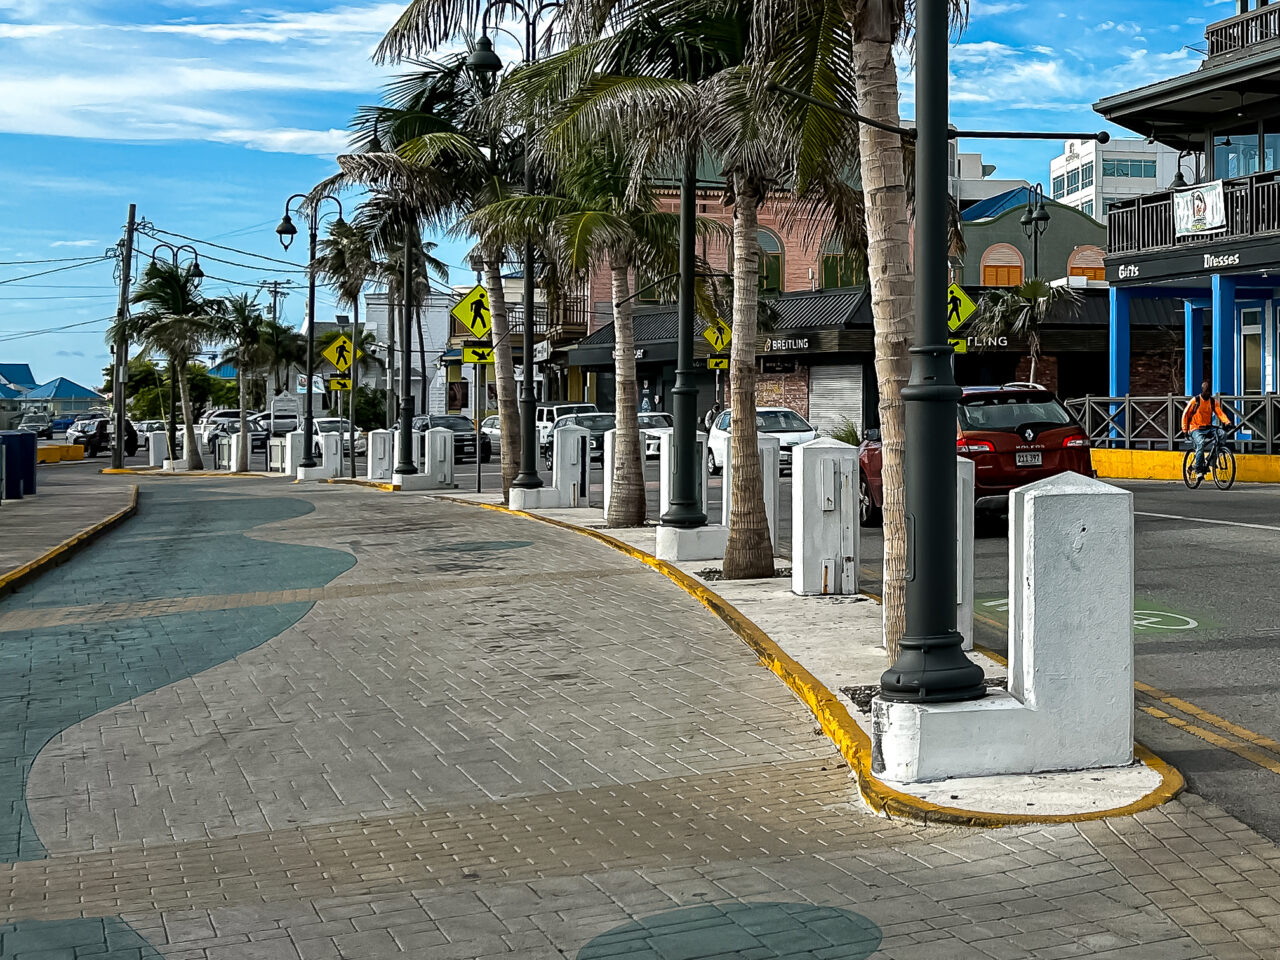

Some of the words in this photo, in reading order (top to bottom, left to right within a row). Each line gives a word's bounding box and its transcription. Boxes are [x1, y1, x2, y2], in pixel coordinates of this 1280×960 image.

[1203, 253, 1240, 269] Dresses
[1118, 264, 1139, 280] Gifts
[772, 338, 809, 351] BREITLING
[967, 336, 1008, 347] TLING
